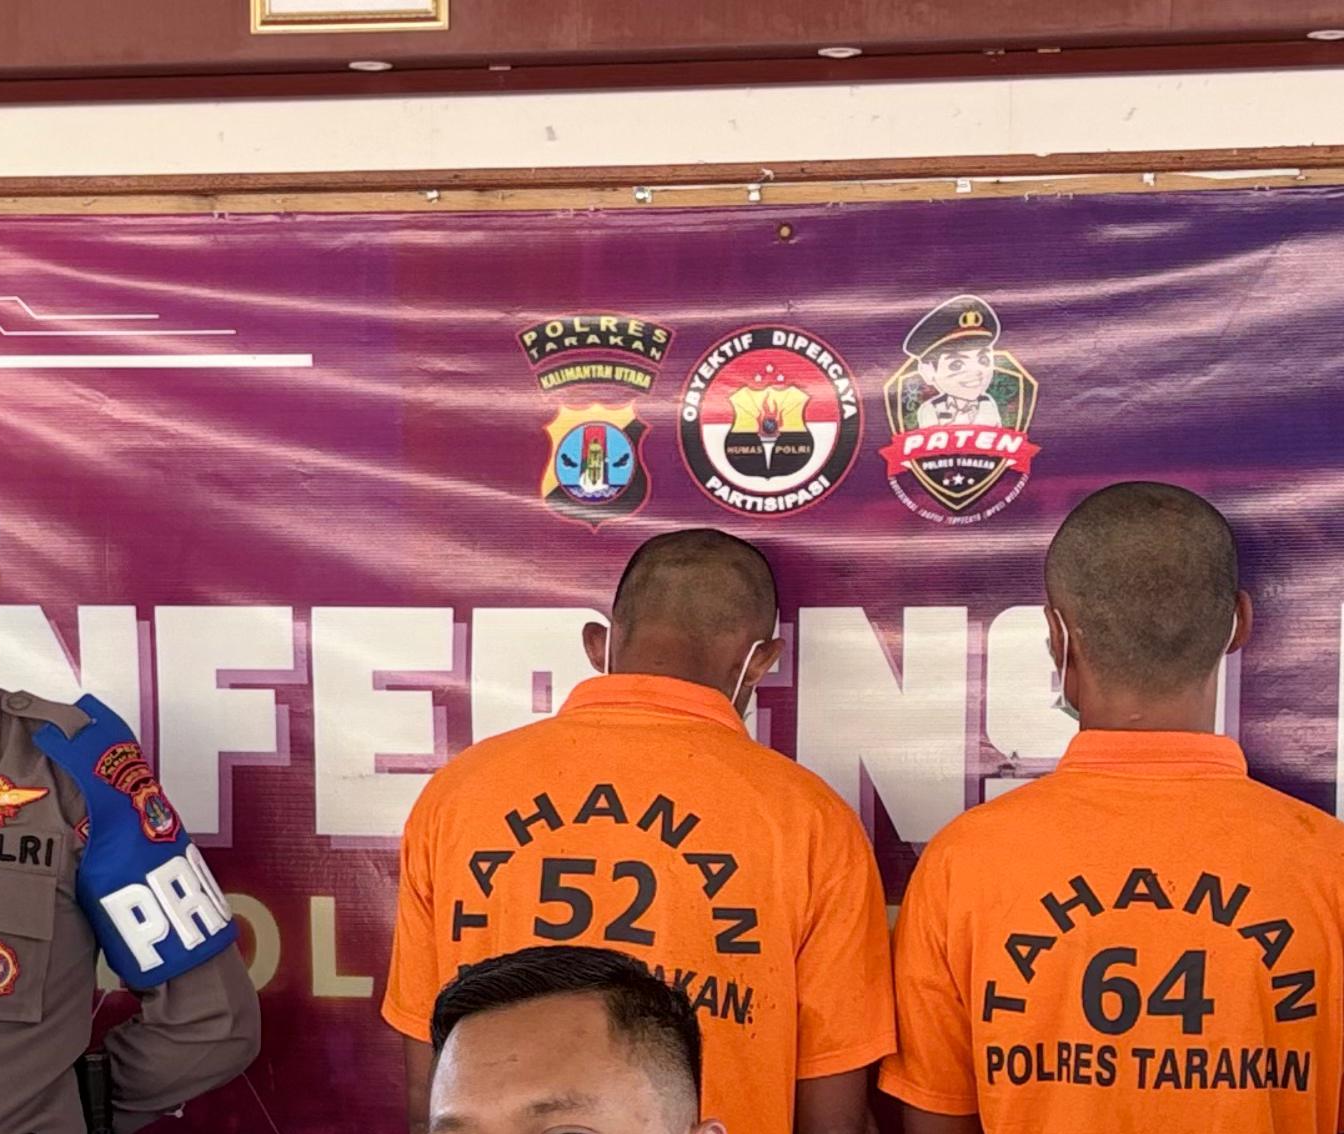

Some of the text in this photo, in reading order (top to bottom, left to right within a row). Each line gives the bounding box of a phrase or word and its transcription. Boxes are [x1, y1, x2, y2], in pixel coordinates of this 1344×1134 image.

[522, 316, 668, 347] POLRES
[529, 334, 662, 361] TARAKAN
[540, 364, 652, 390] KALIMANTAN UTARA
[682, 333, 753, 423] OBYEKTIF
[772, 330, 858, 420] DIPERCAYA
[903, 429, 1024, 455] PATEN
[706, 475, 831, 512] PARTISIPASI
[452, 783, 762, 955] TAHANAN
[532, 856, 658, 947] 52
[981, 867, 1318, 1023] TAHANAN
[1080, 946, 1216, 1036] 64
[986, 1042, 1311, 1092] POLRES TARAKAN
